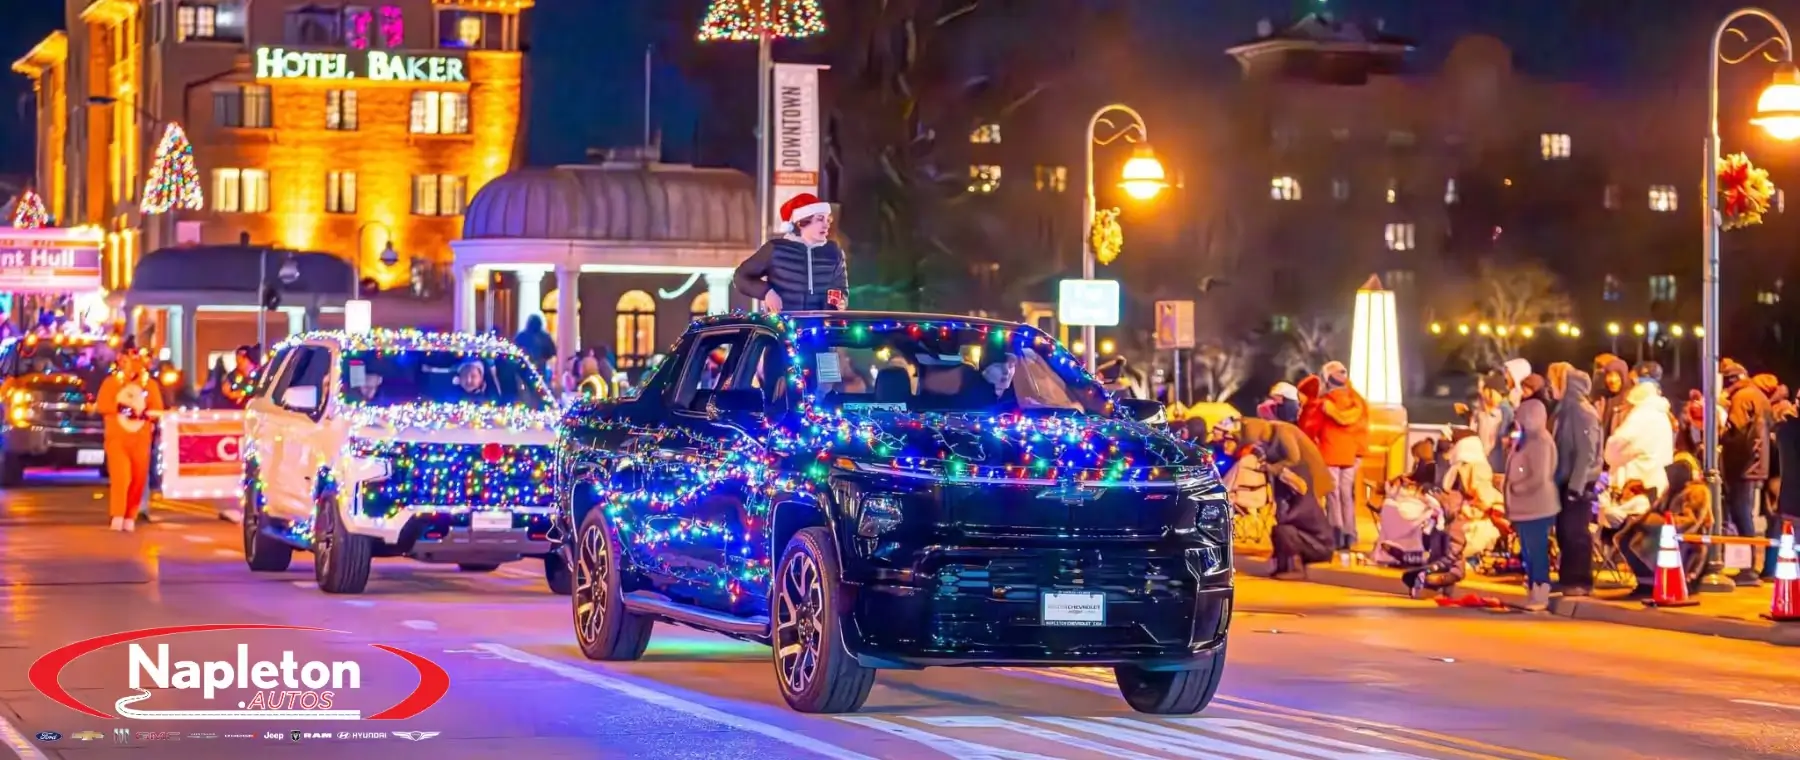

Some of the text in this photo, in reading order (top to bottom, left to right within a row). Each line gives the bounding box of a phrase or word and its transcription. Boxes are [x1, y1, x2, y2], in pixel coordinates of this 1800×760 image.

[256, 48, 465, 81] HOTEL BAKER
[781, 86, 801, 168] DOWNTOWN
[0, 249, 75, 267] nt Hull
